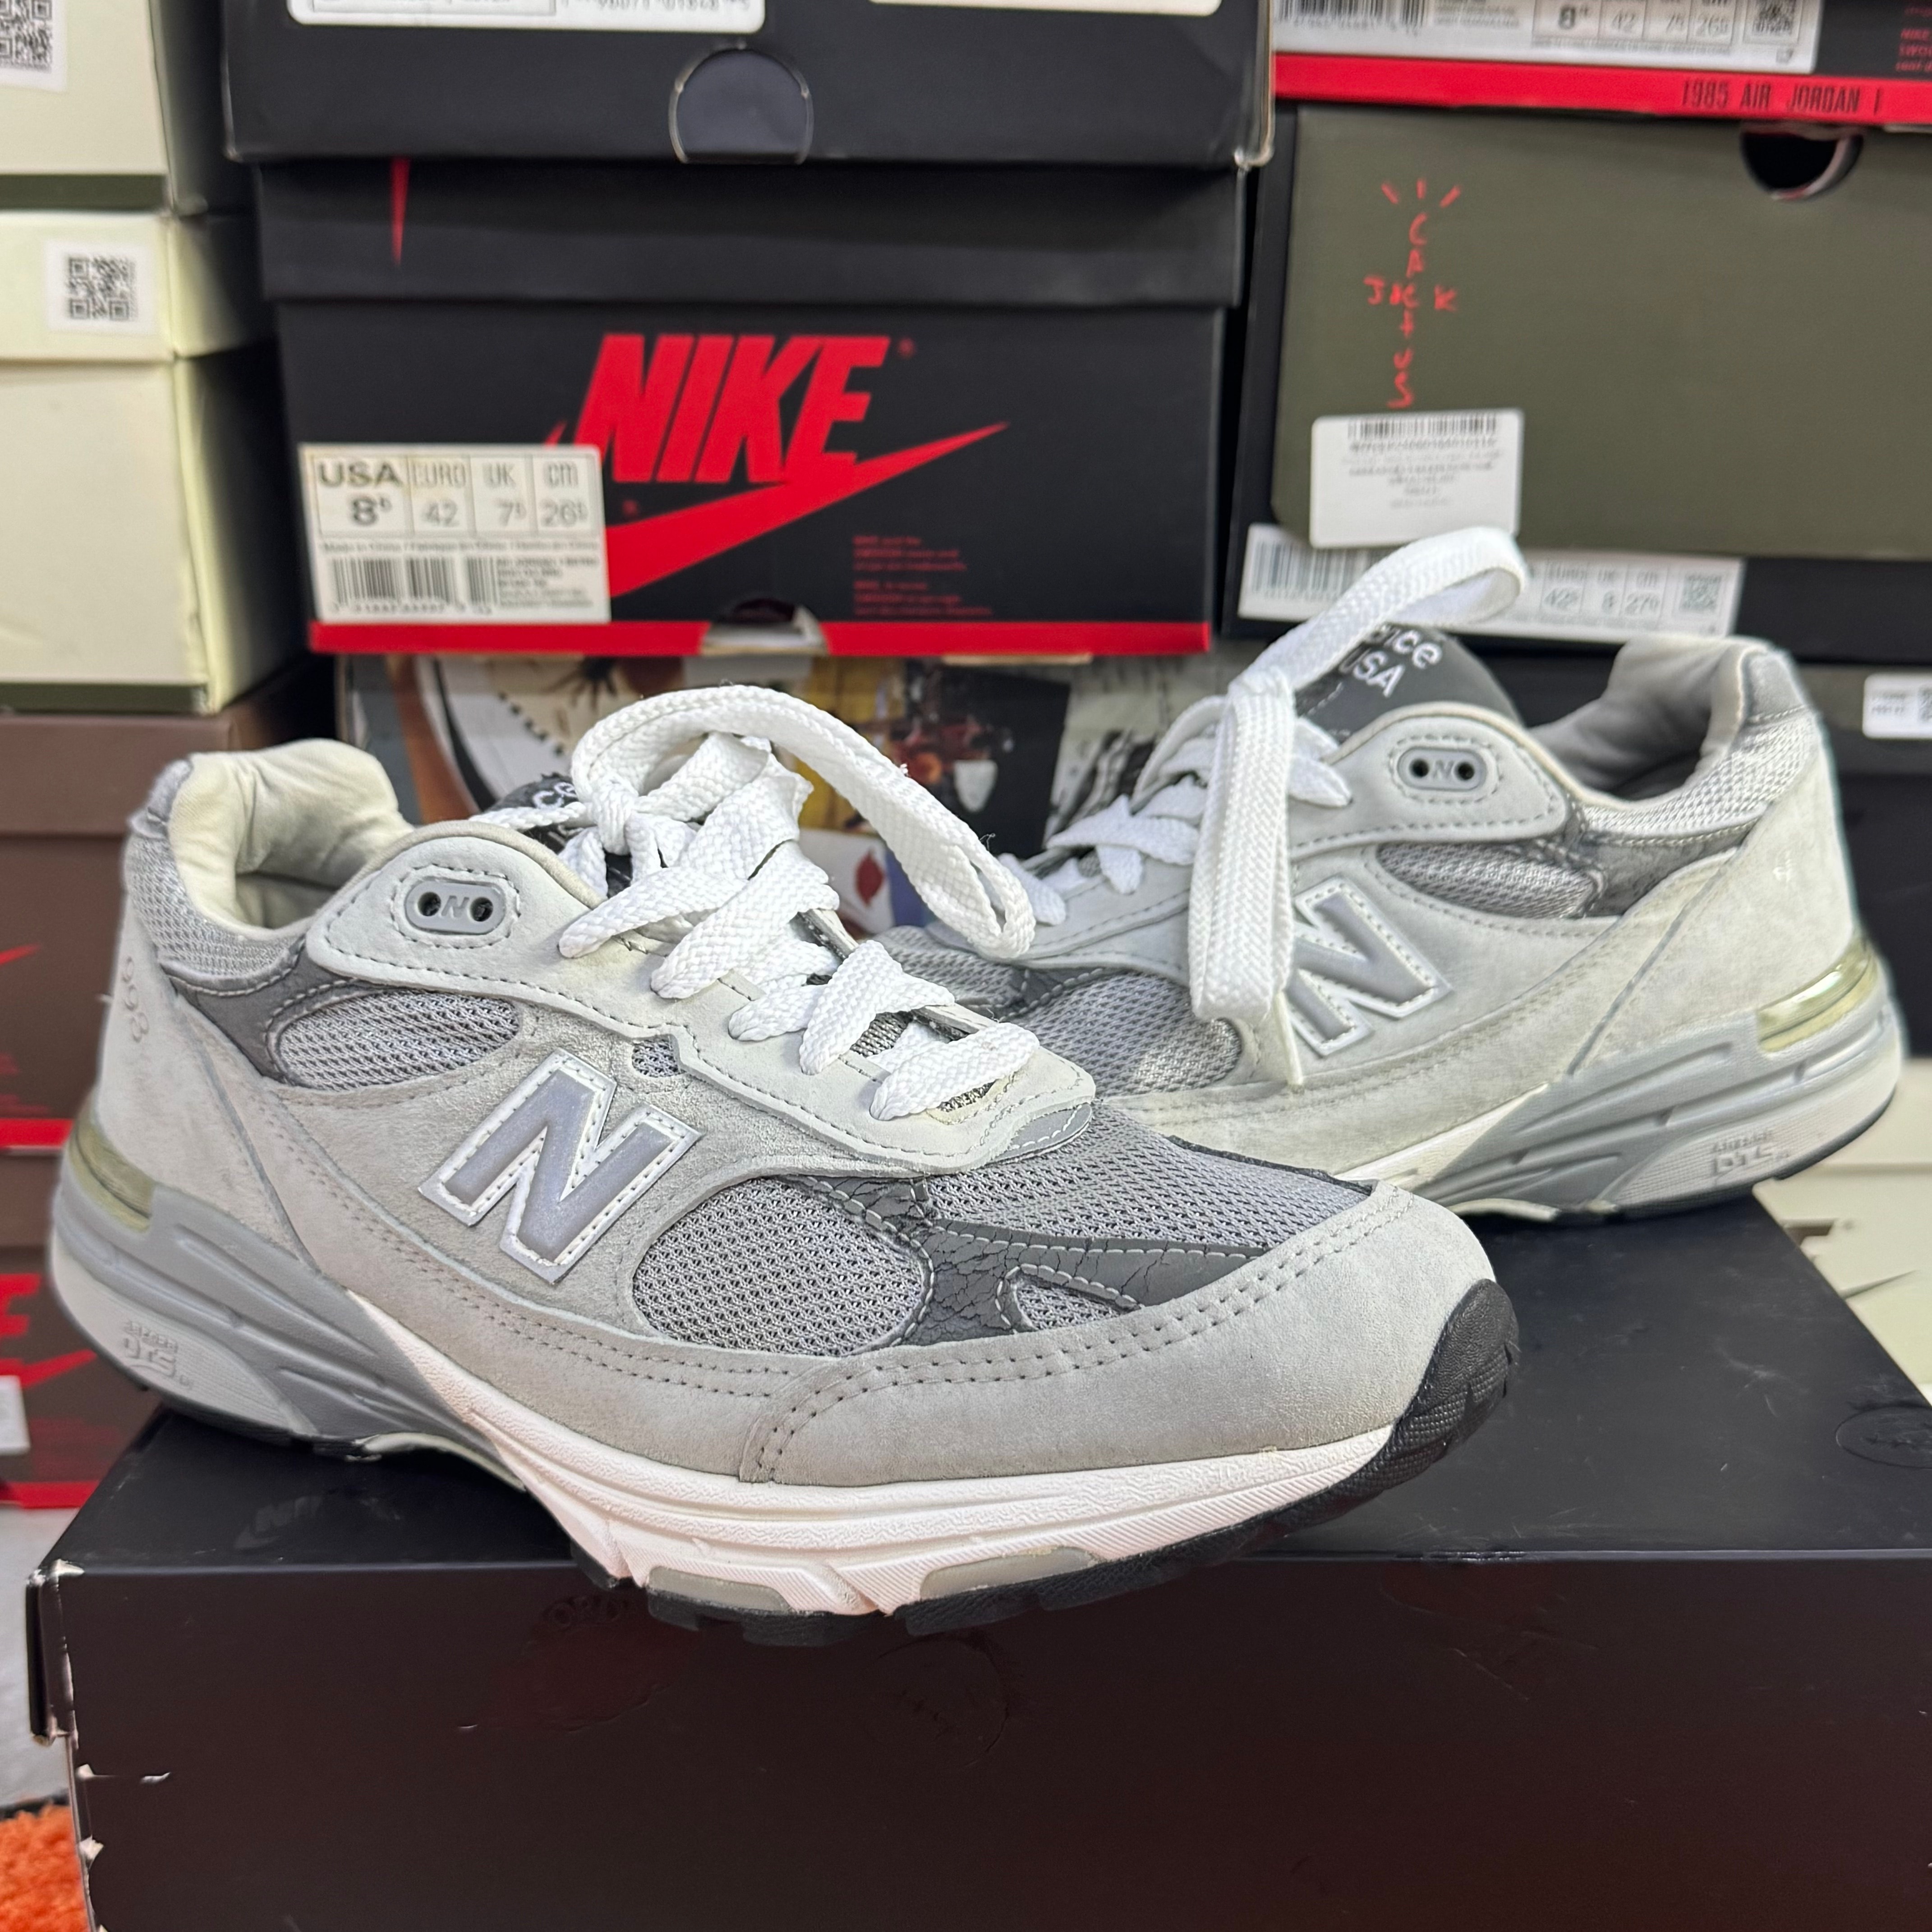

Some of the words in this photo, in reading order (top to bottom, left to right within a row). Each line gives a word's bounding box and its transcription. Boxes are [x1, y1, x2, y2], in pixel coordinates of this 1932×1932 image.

[1682, 79, 1729, 110] 1985
[1740, 81, 1771, 110] AIR
[1787, 84, 1860, 114] JORDAN
[574, 333, 891, 483] NIKE
[318, 460, 405, 488] USA
[413, 461, 467, 488] EURO
[483, 462, 516, 488] UK
[424, 499, 460, 528] 42
[1283, 871, 1456, 1058] N
[418, 1047, 706, 1285] N
